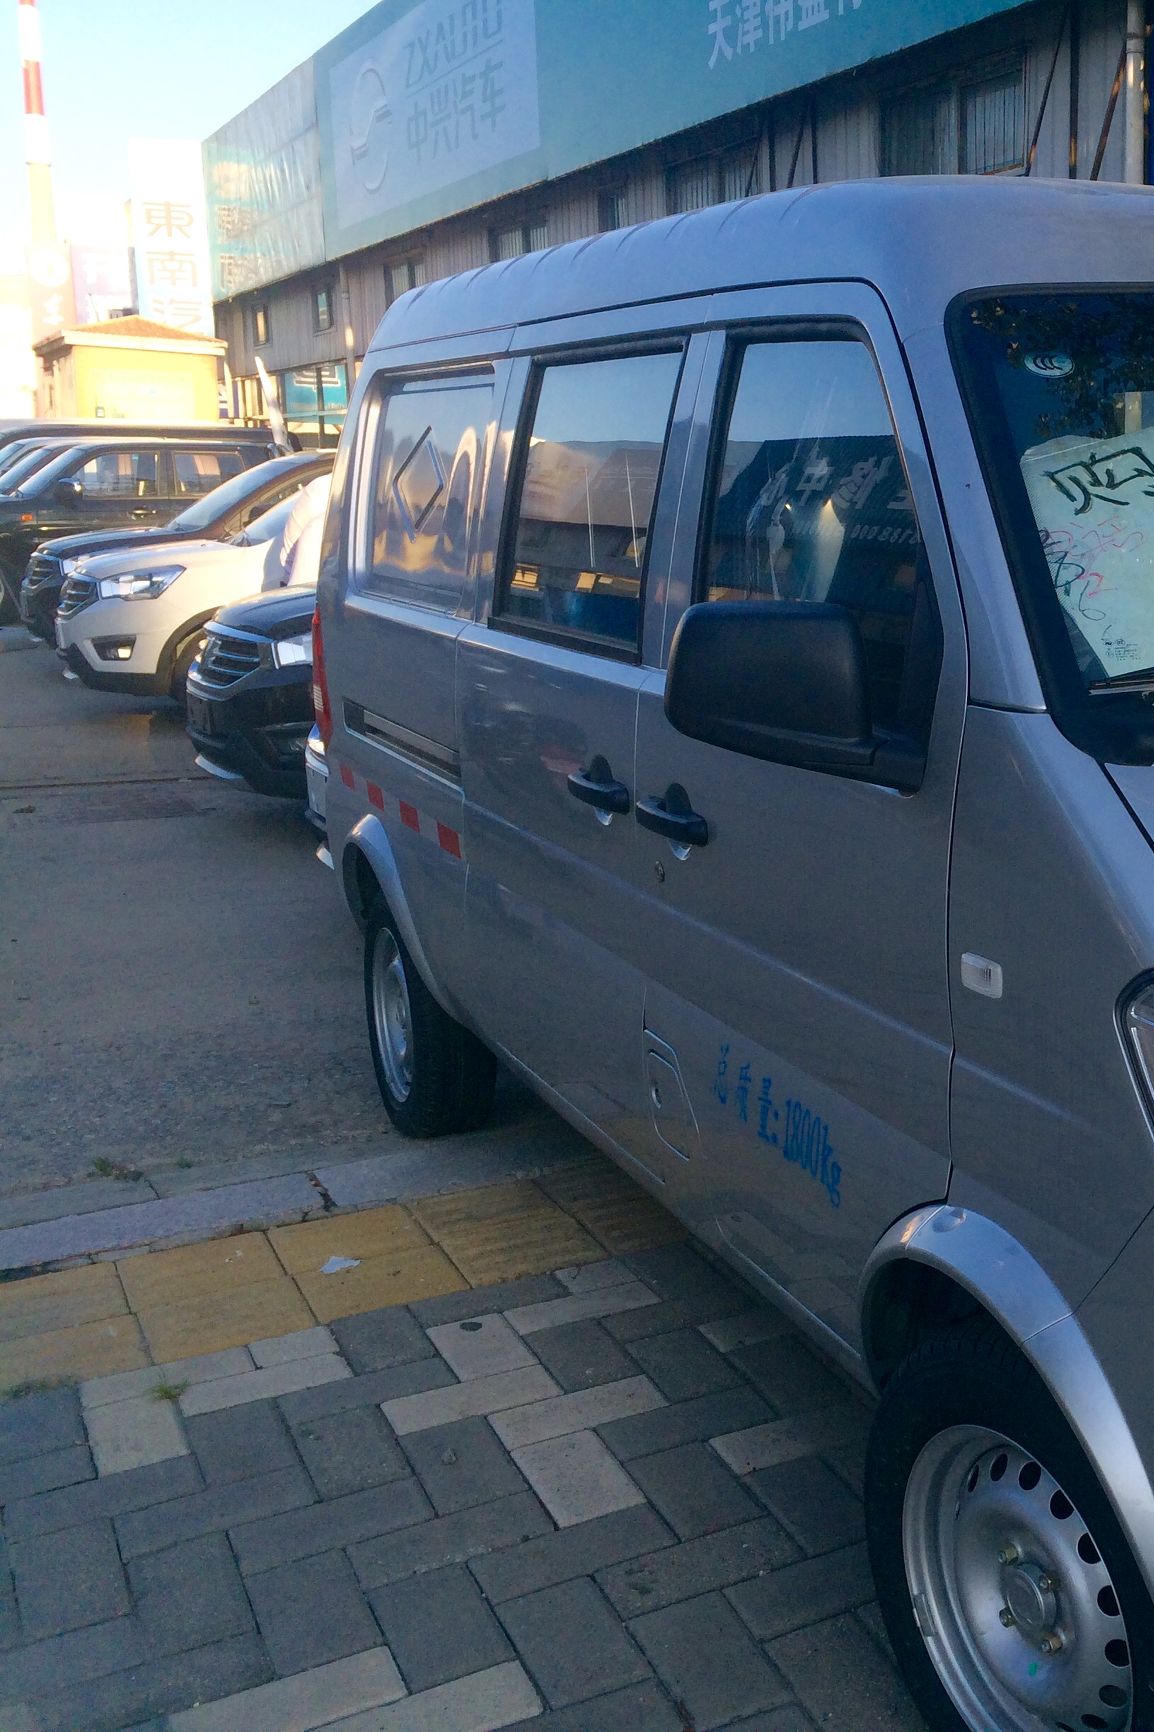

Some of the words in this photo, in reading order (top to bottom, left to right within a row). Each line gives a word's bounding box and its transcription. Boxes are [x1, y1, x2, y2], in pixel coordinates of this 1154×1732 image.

[708, 0, 861, 70] 天津伟
[407, 57, 506, 166] 中兴汽车
